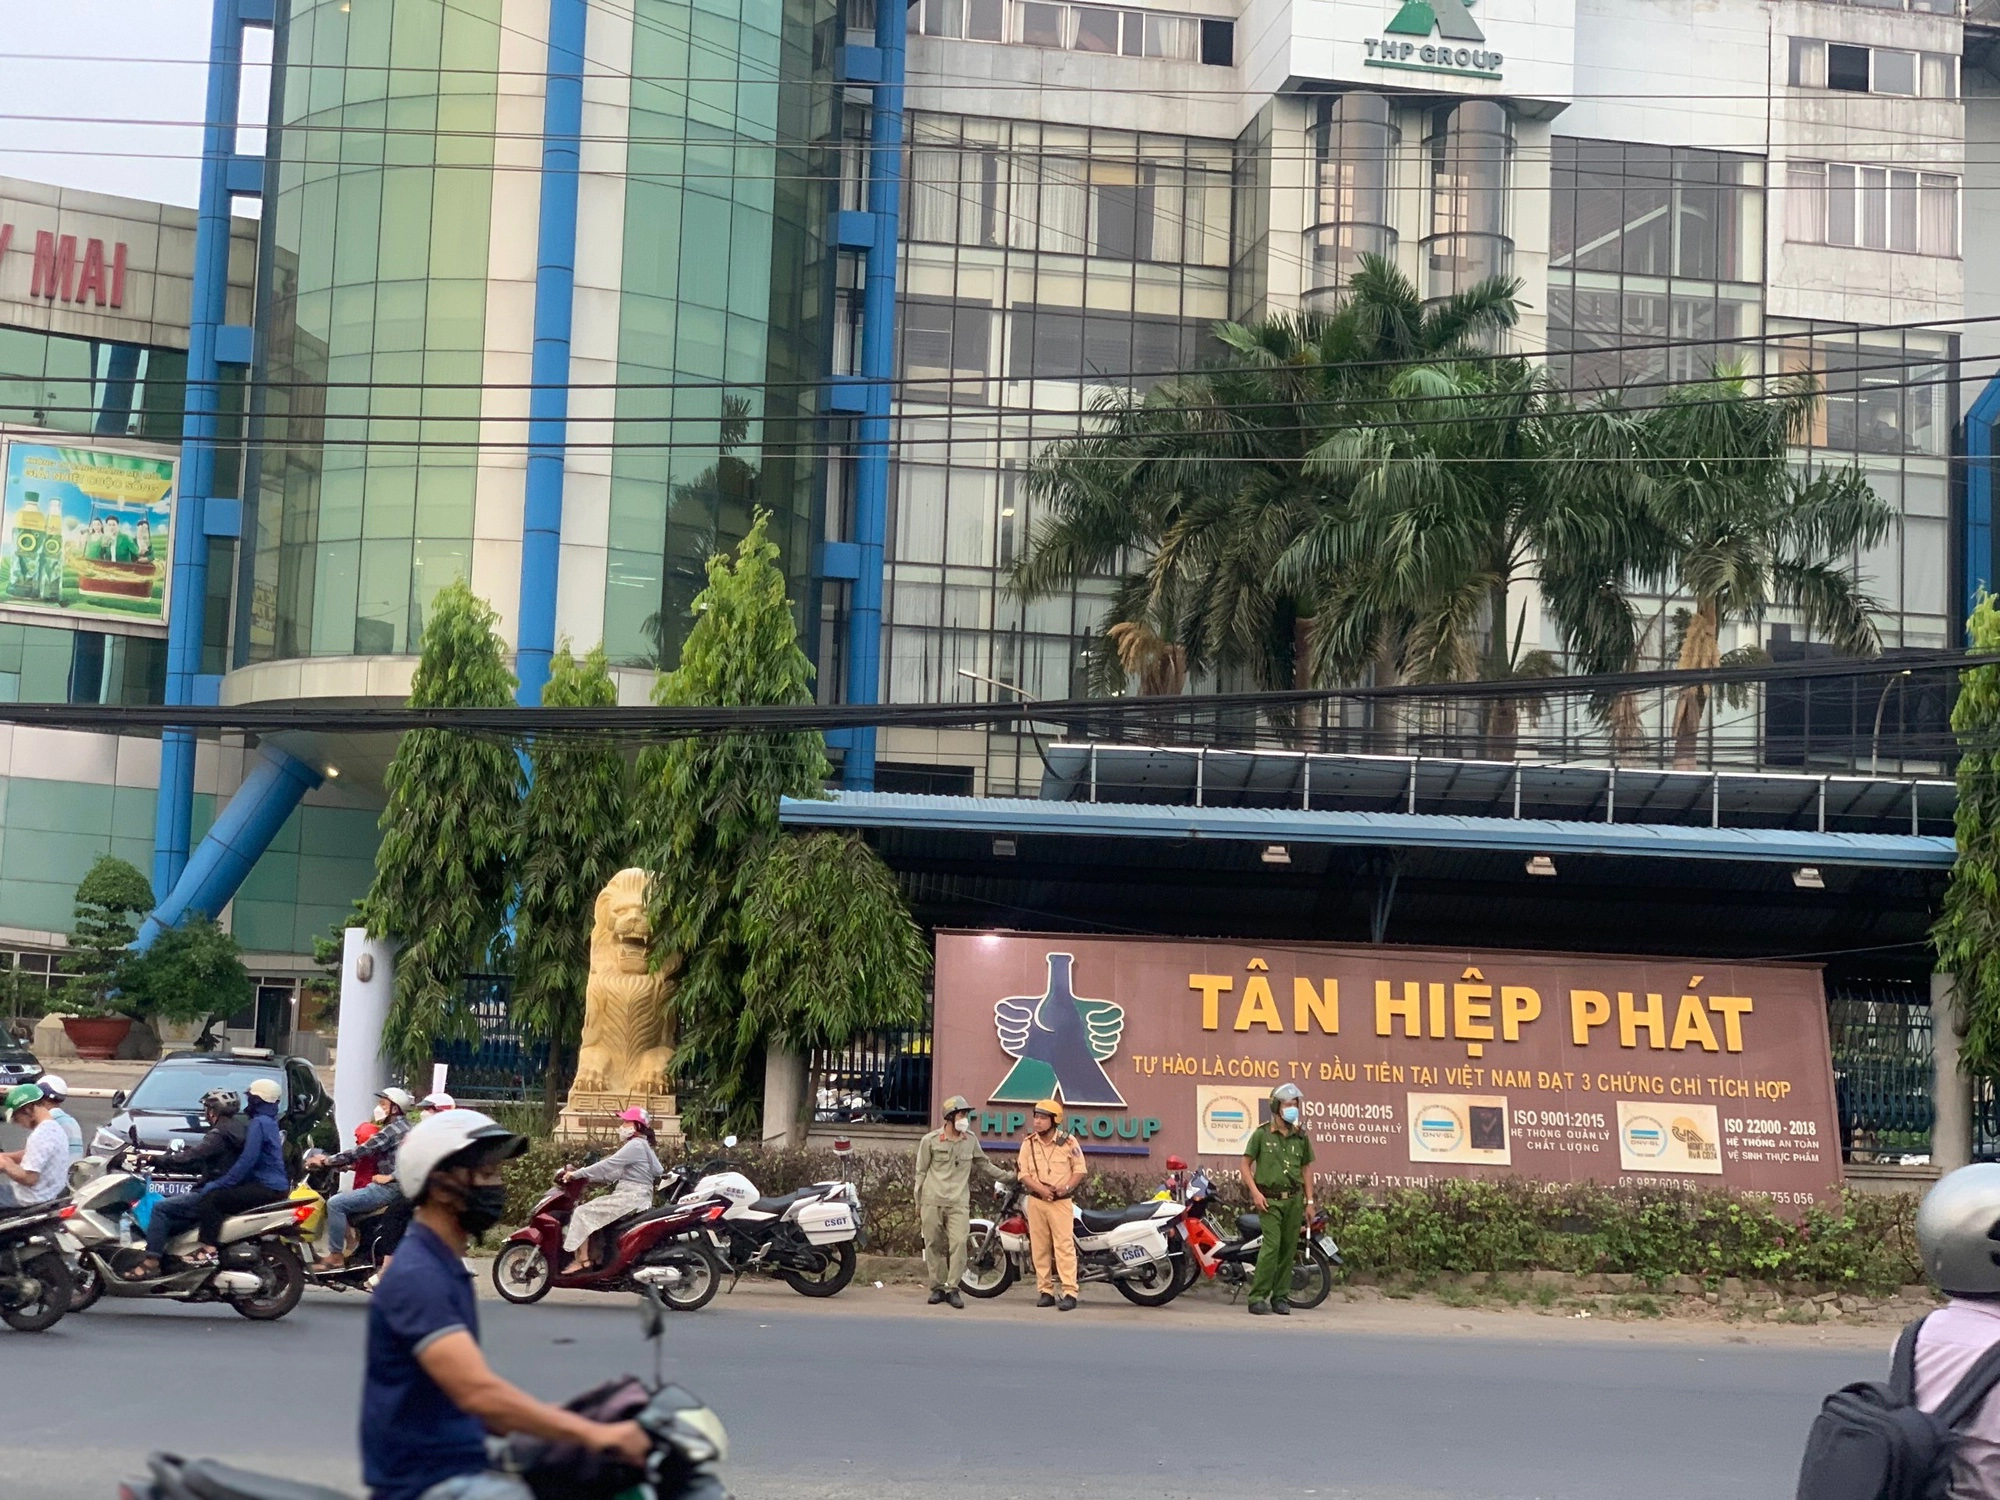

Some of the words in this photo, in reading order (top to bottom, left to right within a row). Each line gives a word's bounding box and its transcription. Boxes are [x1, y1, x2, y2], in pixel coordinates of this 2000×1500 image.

[1364, 38, 1414, 60] THP
[1420, 44, 1503, 70] GROUP
[30, 230, 127, 308] MAI
[87, 476, 122, 489] CUỘC
[125, 479, 159, 492] SỐNG
[1189, 958, 1339, 1033] TÂN
[1375, 967, 1542, 1057] HIỆP
[1570, 975, 1753, 1052] PHÁT
[1132, 1055, 1158, 1078] TỰ
[1162, 1053, 1198, 1075] HÀO
[1202, 1055, 1225, 1076] LÀ
[1228, 1056, 1280, 1078] CÔNG
[1288, 1061, 1312, 1080] TY
[1319, 1055, 1356, 1081] ĐẦU
[1363, 1061, 1404, 1084] TIÊN
[1410, 1066, 1438, 1087] TẠI
[1445, 1063, 1485, 1089] VIỆT
[1491, 1069, 1532, 1089] NAM
[1537, 1071, 1574, 1093] ĐẠT
[1581, 1073, 1591, 1091] 3
[1597, 1071, 1664, 1095] CHỨNG
[1707, 1075, 1749, 1097] TÍCH
[1755, 1080, 1791, 1102] HỢP
[1302, 1101, 1325, 1117] ISO
[1327, 1103, 1393, 1119] 14001:2015
[1057, 1114, 1162, 1139] ROUP
[1514, 1110, 1537, 1125] ISO
[1541, 1111, 1605, 1128] 9001:2015
[1724, 1118, 1743, 1133] ISO
[1746, 1119, 1781, 1134] 22000
[1789, 1121, 1816, 1135] 2018
[1779, 1140, 1791, 1148] AN
[1794, 1138, 1819, 1149] TOÀN
[1742, 1151, 1762, 1160] SINH
[1771, 1191, 1790, 1204] 755
[1793, 1192, 1814, 1205] 056
[824, 1217, 848, 1227] CSGT
[1122, 1247, 1145, 1261] CSGT
